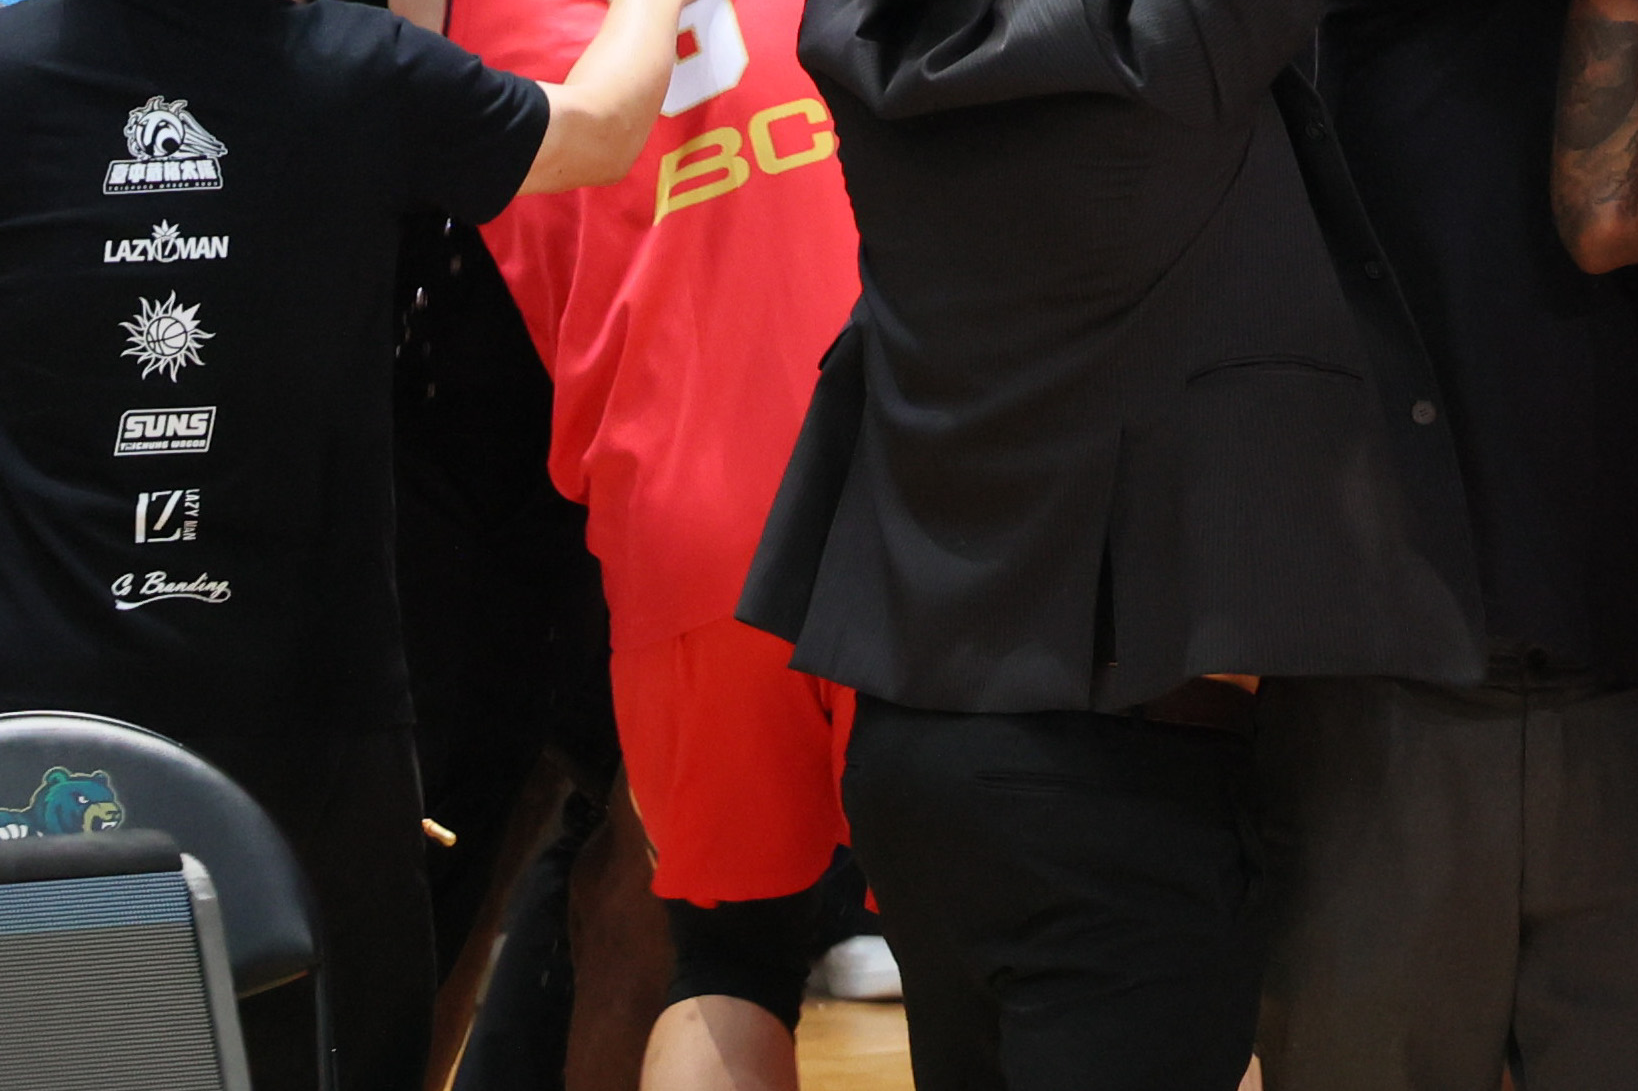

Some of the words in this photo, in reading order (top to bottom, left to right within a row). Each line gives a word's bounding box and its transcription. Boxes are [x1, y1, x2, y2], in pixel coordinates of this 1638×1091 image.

[650, 97, 835, 227] BC
[123, 412, 210, 439] SUNS
[139, 570, 231, 602] Branding
